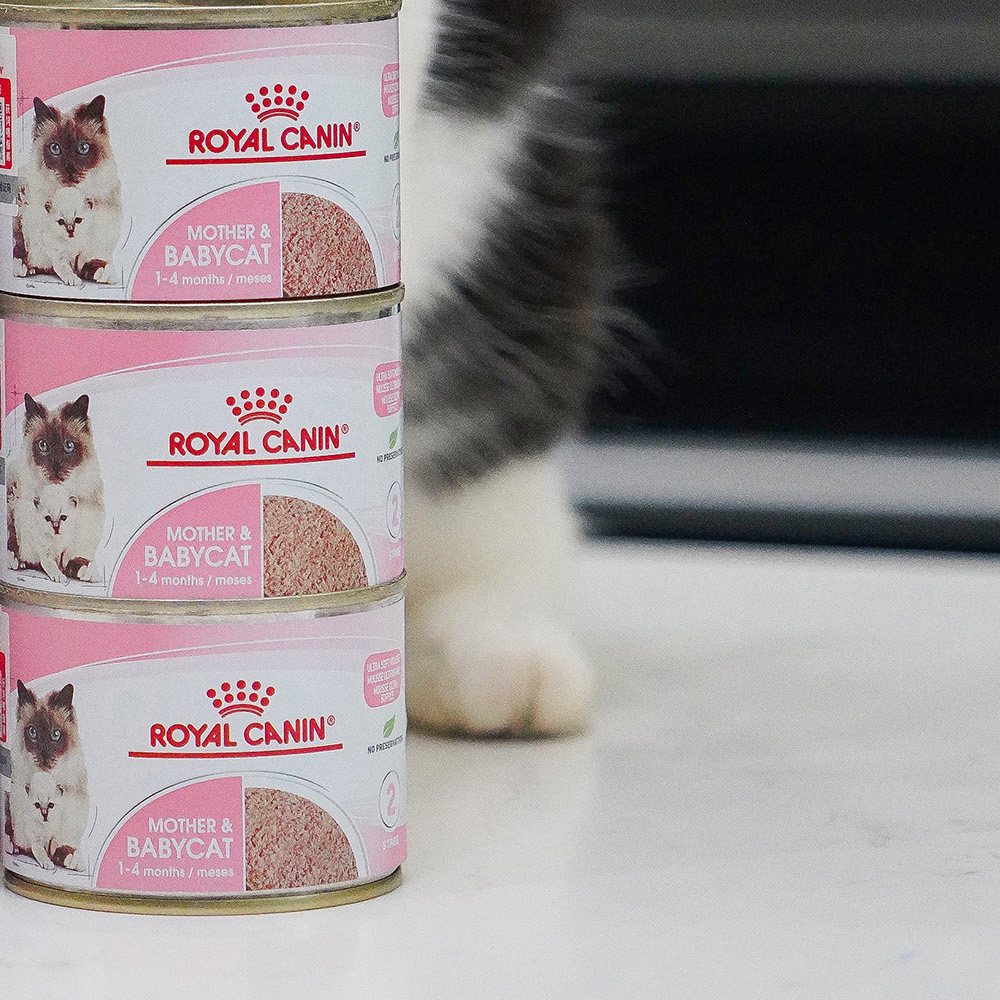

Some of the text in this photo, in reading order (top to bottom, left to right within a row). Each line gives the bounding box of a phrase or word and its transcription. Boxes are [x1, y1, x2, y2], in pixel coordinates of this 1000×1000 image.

[189, 128, 274, 154] ROYAL
[187, 223, 271, 241] MOTHER &
[164, 242, 272, 267] BABYCAT
[155, 270, 179, 286] 1-4
[181, 272, 225, 285] months
[235, 274, 272, 285] meses
[170, 432, 255, 455] ROYAL
[166, 525, 252, 542] MOTHER &
[144, 544, 252, 568] BABYCAT
[135, 570, 158, 585] 1-4
[161, 573, 204, 586] months
[214, 575, 253, 586] meses
[151, 723, 236, 747] ROYAL
[367, 745, 375, 755] NO
[386, 782, 396, 817] 2
[148, 817, 233, 834] MOTHER &
[127, 836, 234, 860] BABYCAT
[118, 862, 141, 876] 1-4
[143, 865, 186, 878] months
[196, 868, 235, 878] meses
